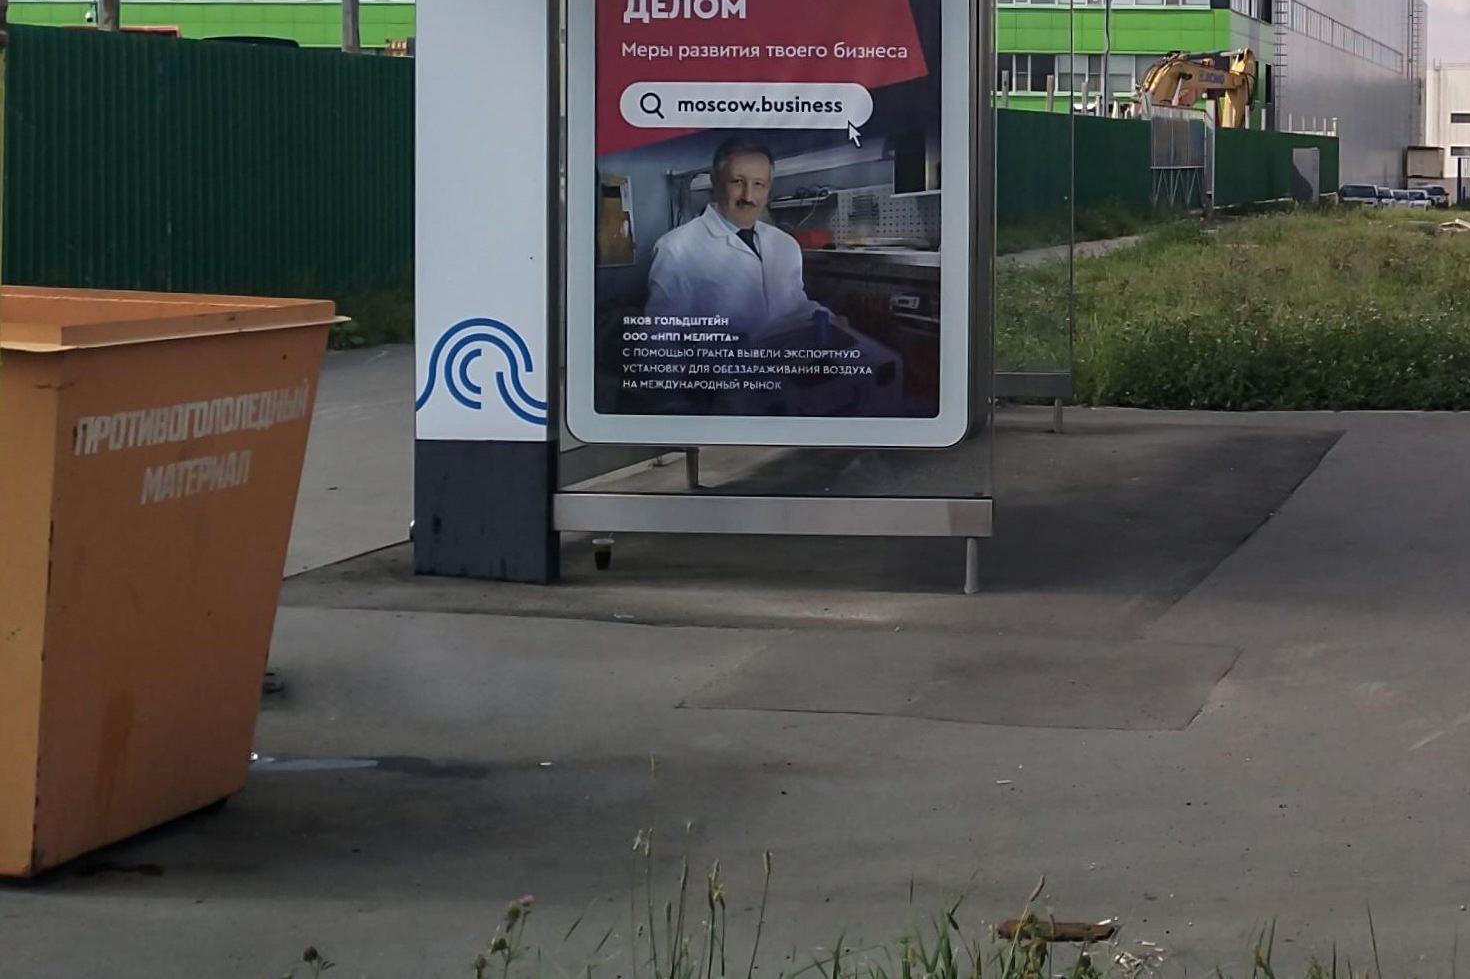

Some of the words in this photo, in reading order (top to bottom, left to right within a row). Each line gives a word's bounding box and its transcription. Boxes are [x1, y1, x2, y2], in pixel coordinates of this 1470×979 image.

[621, 42, 674, 60] Меры
[678, 44, 760, 60] развития
[766, 44, 828, 59] твоего
[833, 41, 908, 59] бизнеса
[677, 95, 843, 113] moscow.business
[622, 316, 652, 326] ЯКОВ
[654, 314, 729, 327] ГОЛЬДШТЕЙН
[622, 332, 648, 341] ООО
[622, 348, 631, 357] С
[633, 348, 694, 359] ПОМОЩЬЮ
[696, 348, 735, 358] ГРАНТА
[737, 349, 781, 358] ВЫВЕЛИ
[783, 349, 861, 359] ЭКСПОРТНУЮ
[622, 364, 686, 374] УСТАНОВКУ
[688, 364, 711, 374] ДЛЯ
[712, 364, 821, 375] ОБЕЗЗАРАЖИВАНИЯ
[823, 365, 874, 376] ВОЗДУХА
[622, 380, 638, 389] НА
[639, 378, 740, 391] МЕЖДУНАРОДНЫЙ
[742, 380, 783, 390] РЫНОК
[73, 377, 310, 457] ПРОТИВОГОЛОЛЕДНЫЙ
[140, 448, 252, 505] МАТЕРИАЛ
